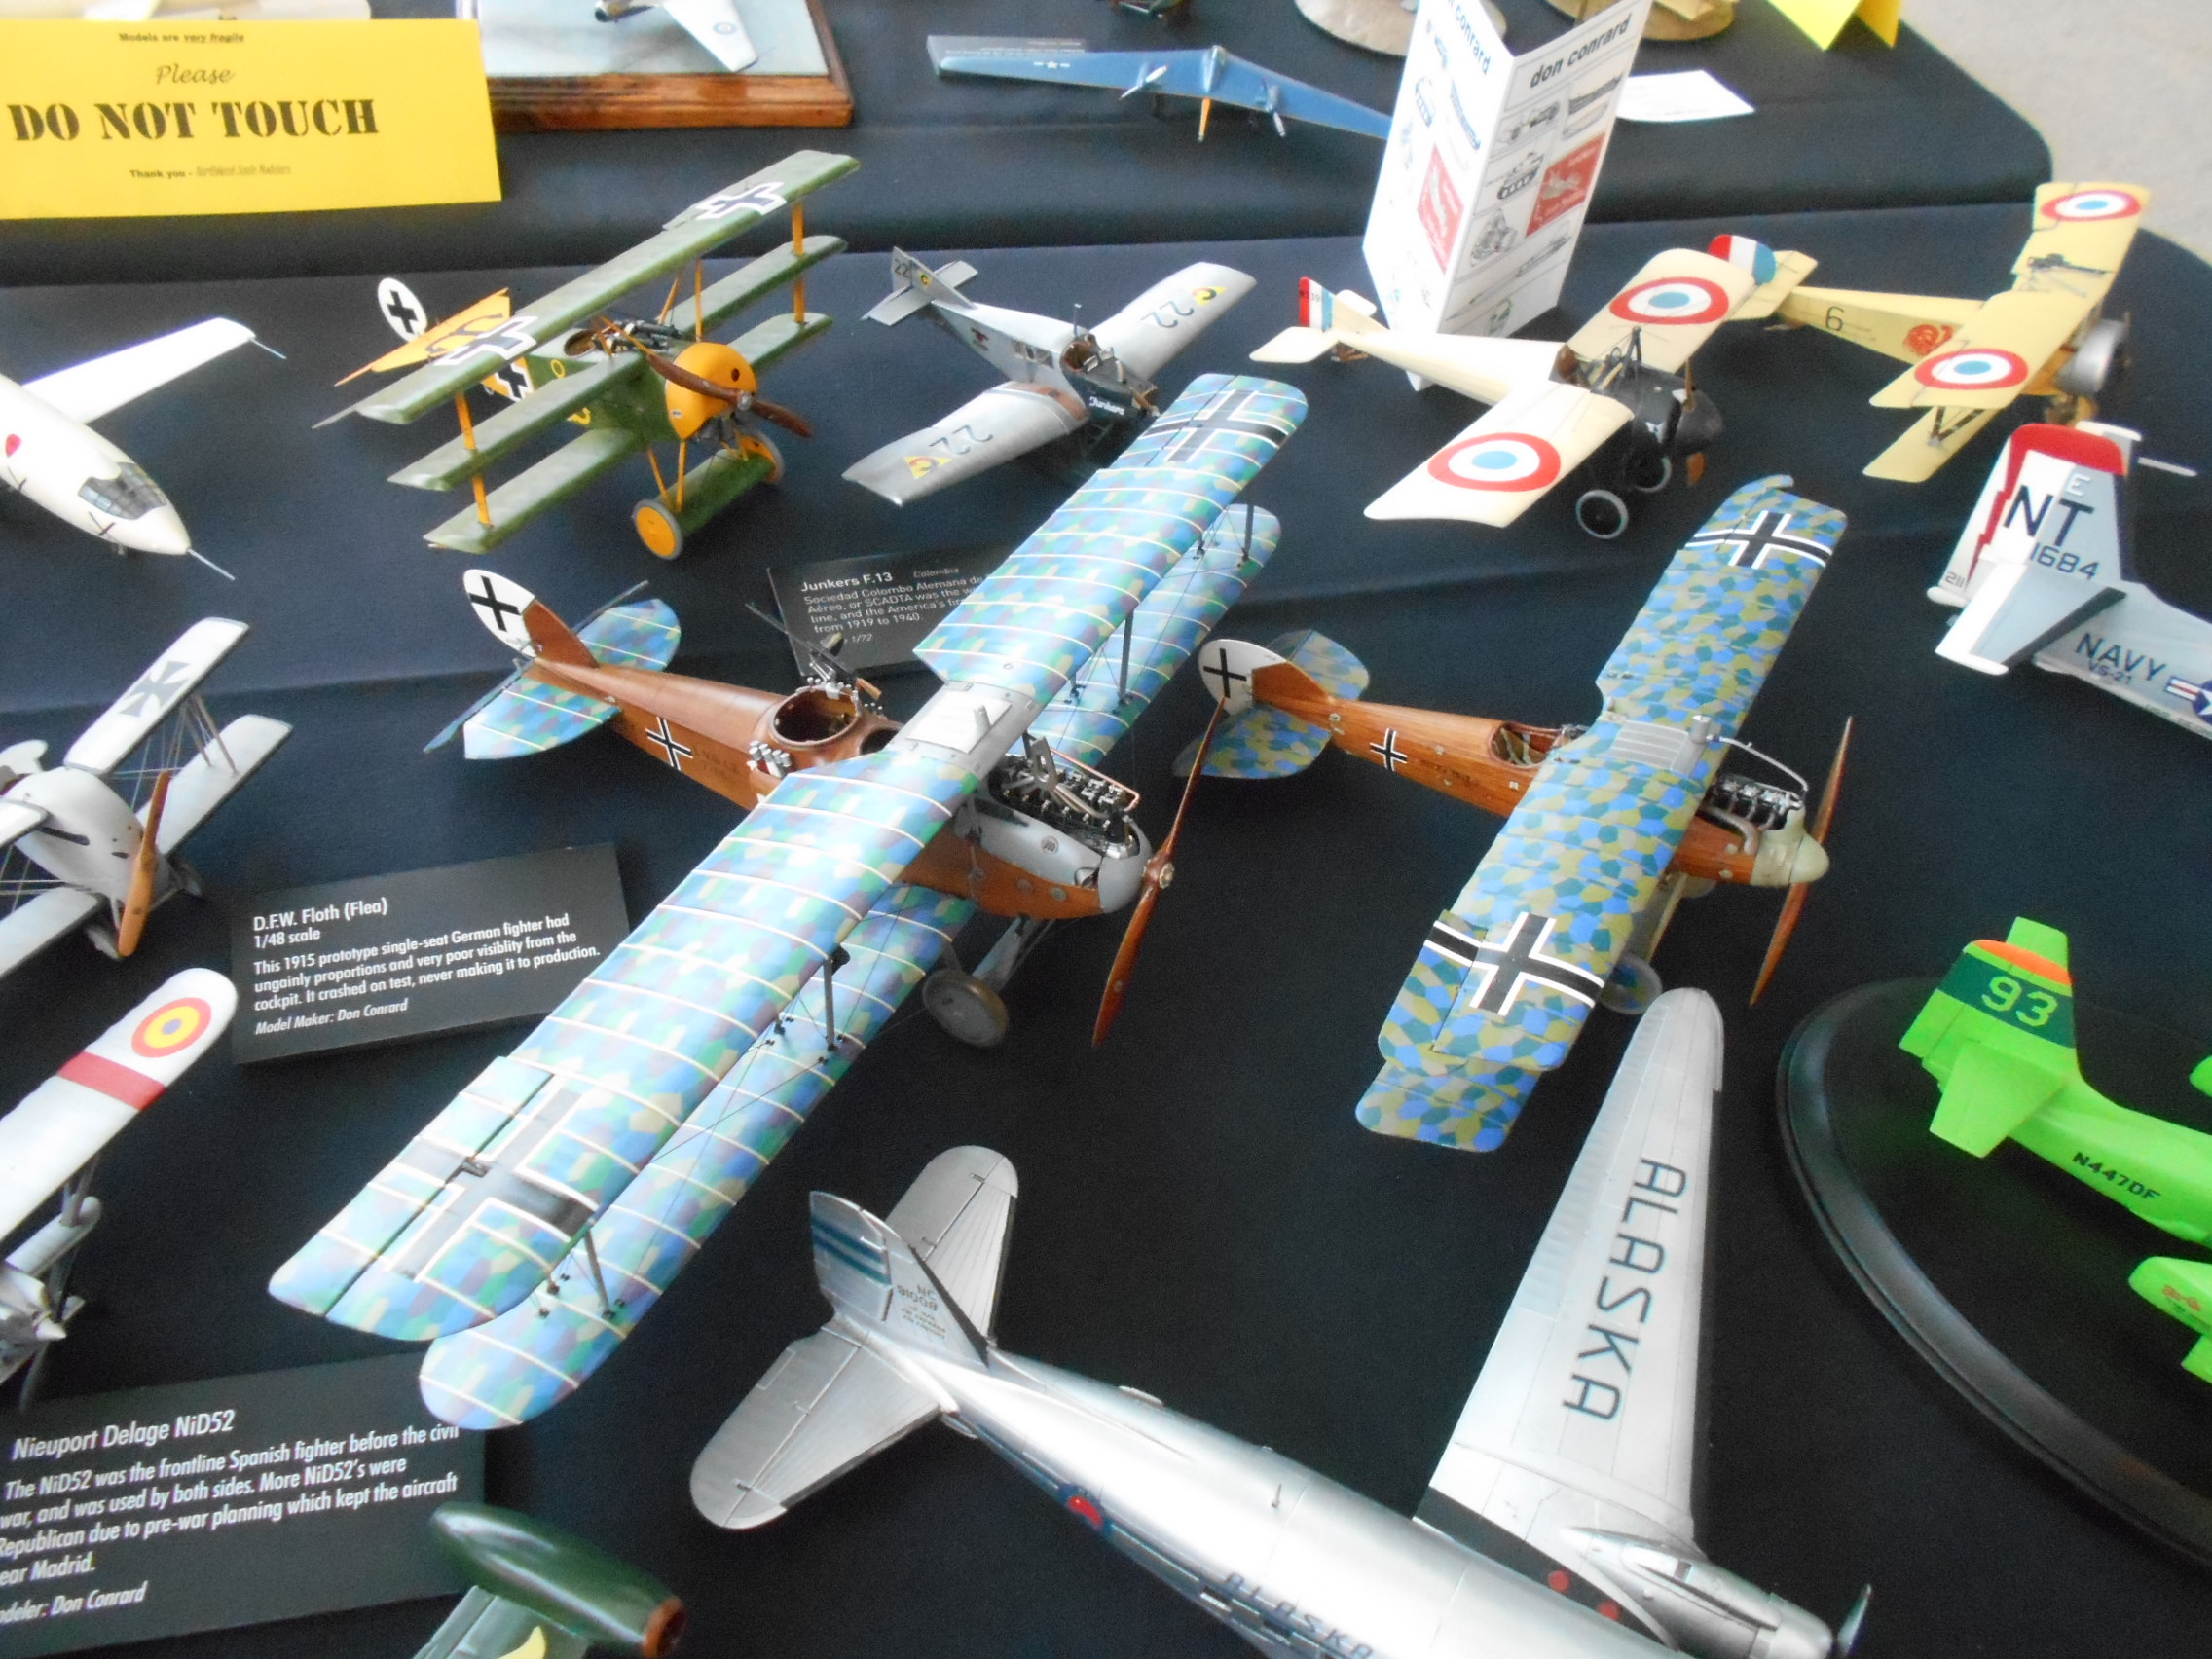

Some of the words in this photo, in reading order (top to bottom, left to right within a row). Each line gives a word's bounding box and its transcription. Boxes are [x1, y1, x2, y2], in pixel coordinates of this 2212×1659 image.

[119, 33, 158, 42] Models
[184, 34, 206, 43] very
[210, 33, 244, 43] fragile
[1456, 5, 1491, 75] conrard
[1530, 58, 1564, 88] don
[1567, 13, 1632, 67] conrard
[155, 63, 235, 85] Please
[7, 102, 80, 141] DO
[94, 101, 195, 140] NOT
[212, 98, 379, 137] TOUCH
[129, 169, 164, 178] Thank
[167, 170, 186, 179] you
[1825, 306, 1845, 331] 6
[2003, 485, 2094, 547] NT
[801, 577, 860, 592] Junkers
[862, 571, 893, 584] F.13
[2030, 543, 2099, 580] 1684
[803, 590, 859, 605] Sociedad
[861, 585, 914, 598] Colombo
[916, 578, 967, 591] Alemana
[849, 601, 862, 609] or
[865, 593, 914, 608] SCADTA
[914, 592, 940, 601] was
[940, 589, 960, 598] the
[813, 623, 844, 634] from
[846, 617, 874, 629] 1919
[842, 609, 863, 620] and
[865, 608, 884, 616] the
[2075, 634, 2166, 682] NAVY
[301, 903, 340, 924] Floth
[344, 896, 388, 921] (Flea)
[253, 960, 281, 975] This
[284, 952, 315, 970] 1915
[318, 946, 379, 968] prototype
[381, 934, 449, 955] single-seat
[451, 927, 501, 944] German
[502, 920, 543, 938] fighter
[545, 912, 570, 929] had
[254, 931, 286, 949] 1/48
[288, 926, 321, 944] scale
[254, 972, 312, 993] ungainly
[313, 962, 387, 986] proportions
[388, 954, 414, 972] and
[416, 954, 443, 967] very
[445, 948, 475, 965] poor
[476, 940, 524, 957] visiblity
[525, 936, 555, 949] from
[556, 930, 577, 944] the
[254, 992, 303, 1012] cockpit.
[306, 989, 316, 1003] It
[318, 979, 367, 1001] crashed
[369, 980, 387, 992] on
[388, 975, 416, 989] test,
[418, 970, 454, 985] never
[456, 961, 504, 978] making
[505, 958, 515, 971] it
[517, 957, 531, 969] to
[533, 946, 601, 969] production.
[255, 1015, 293, 1035] Model
[293, 1012, 335, 1029] Maker:
[337, 1009, 361, 1022] Don
[363, 997, 409, 1017] Conrard
[1981, 976, 2057, 1027] 93
[1562, 1158, 1687, 1420] ALASKA
[11, 1430, 99, 1461] Nieuport
[101, 1420, 170, 1448] Delage
[174, 1409, 236, 1438] NiD52
[5, 1479, 36, 1501] The
[38, 1469, 92, 1495] NiD52
[94, 1469, 127, 1487] was
[129, 1461, 156, 1483] the
[158, 1454, 227, 1479] frontline
[228, 1442, 291, 1472] Spanish
[293, 1438, 347, 1464] fighter
[349, 1430, 399, 1453] before
[401, 1425, 427, 1445] the
[35, 1498, 71, 1524] and
[74, 1499, 106, 1518] was
[108, 1488, 148, 1513] used
[149, 1486, 170, 1510] by
[172, 1480, 209, 1504] both
[211, 1475, 255, 1499] sides.
[258, 1471, 301, 1493] More
[304, 1458, 365, 1486] NiD52's
[369, 1457, 407, 1476] were
[87, 1521, 121, 1544] due
[124, 1521, 141, 1538] to
[142, 1512, 209, 1540] pre-war
[210, 1500, 283, 1530] planning
[287, 1490, 332, 1515] which
[335, 1487, 371, 1510] kept
[373, 1481, 399, 1502] the
[401, 1471, 459, 1498] aircraft
[0, 1567, 28, 1587] ear
[29, 1551, 95, 1581] Madrid.
[0, 1599, 49, 1625] odeler:
[50, 1595, 84, 1616] Don
[85, 1580, 149, 1610] Conrard
